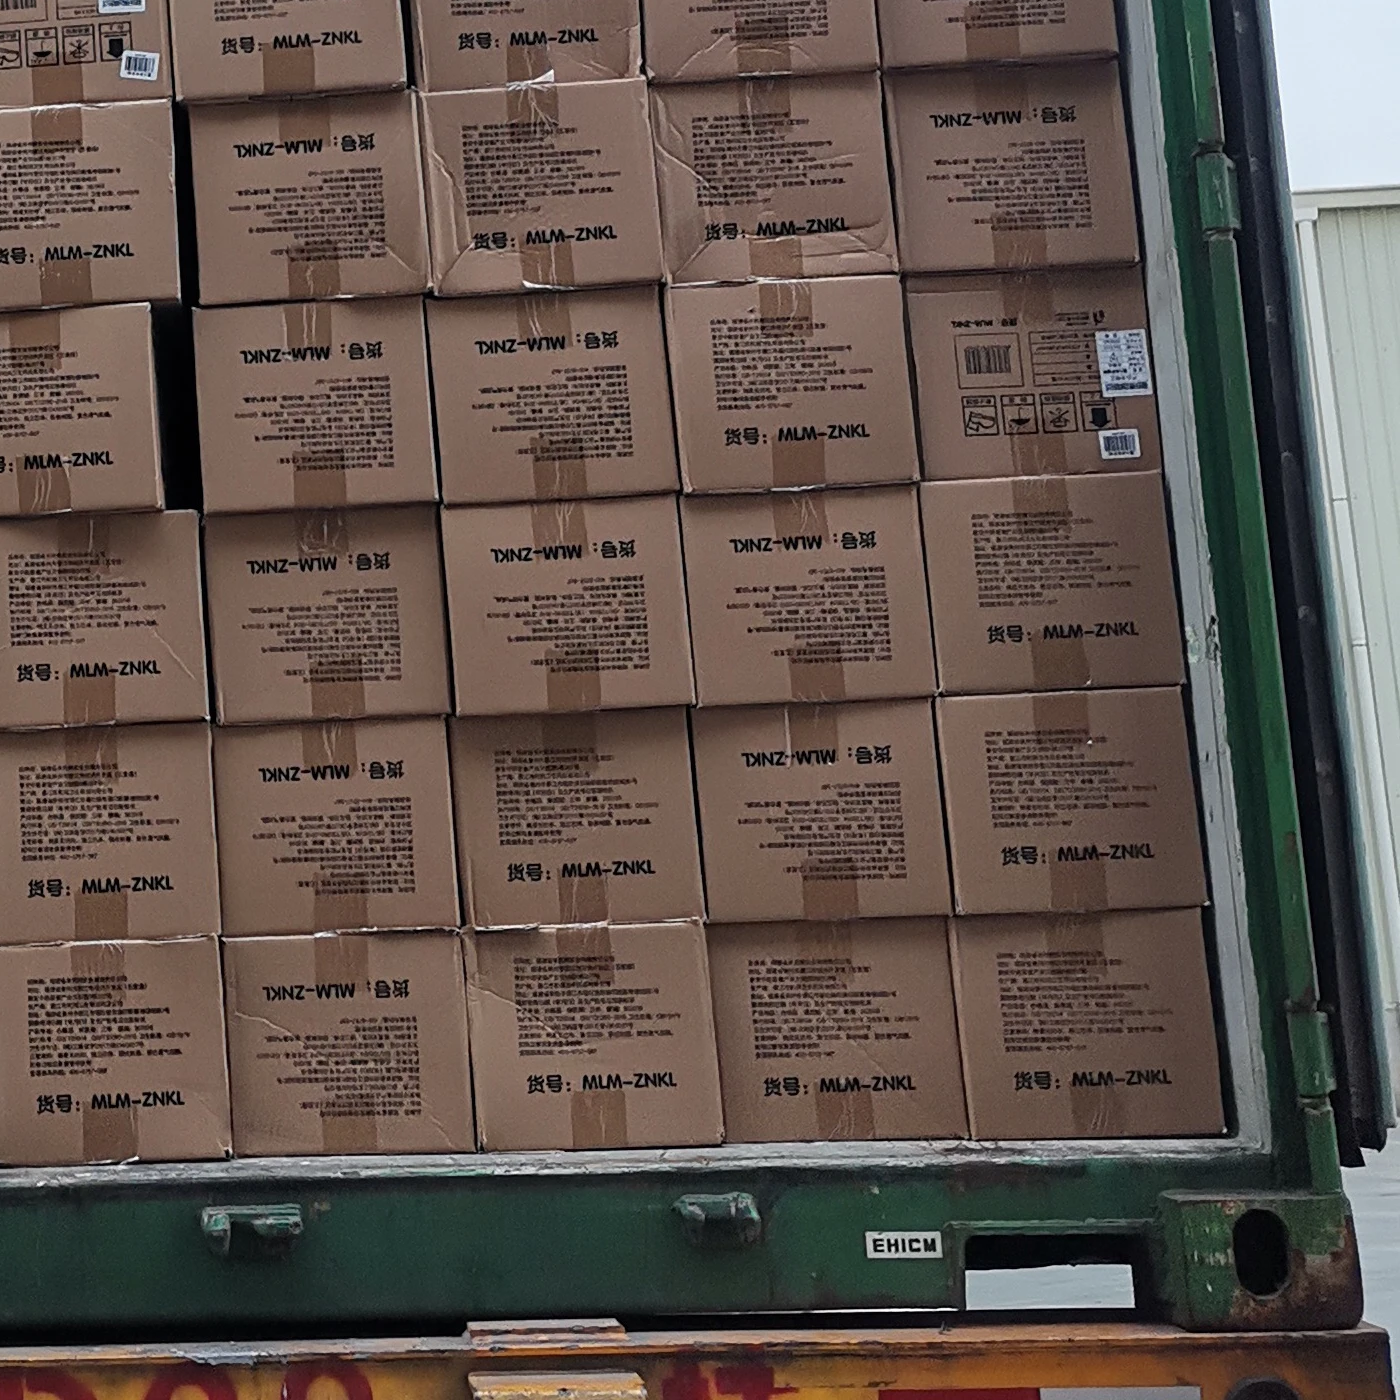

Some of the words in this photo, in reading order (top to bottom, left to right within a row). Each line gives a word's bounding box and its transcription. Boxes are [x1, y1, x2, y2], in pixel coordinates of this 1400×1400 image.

[272, 29, 363, 50] MLM-ZNKL
[509, 27, 600, 48] MLM-ZNKL
[928, 109, 1022, 129] MLM-ZNKL
[232, 137, 324, 159] MLM-ZNKL
[526, 224, 618, 245] MLM-ZNKL
[756, 216, 851, 238] MLM-ZNKL
[44, 242, 135, 262] MLM-ZNKL
[239, 343, 331, 365] MLM-ZNKL
[473, 334, 566, 356] MLM-ZNKL
[777, 423, 871, 443] MLM-ZNKL
[23, 450, 115, 472] MLM-ZNKL
[489, 543, 583, 564] MLM-ZNKL
[728, 534, 823, 554] MLM-ZNKL
[245, 556, 338, 576] MLM-ZNKL
[1042, 620, 1140, 641] MLM-ZNKL
[69, 659, 162, 680] MLM-ZNKL
[257, 762, 351, 783] MLM-ZNKL
[1057, 842, 1156, 863] MLM-ZNKL
[561, 858, 657, 877] MLM-ZNKL
[81, 874, 175, 895] MLM-ZNKL
[261, 982, 356, 1002] MLM-ZNKL
[582, 1071, 678, 1092] MLM-ZNKL
[819, 1074, 917, 1094] MLM-ZNKL
[1072, 1067, 1173, 1089] MLM-ZNKL
[90, 1090, 186, 1110] MLM-ZNKL
[871, 1237, 938, 1254] EHICM
